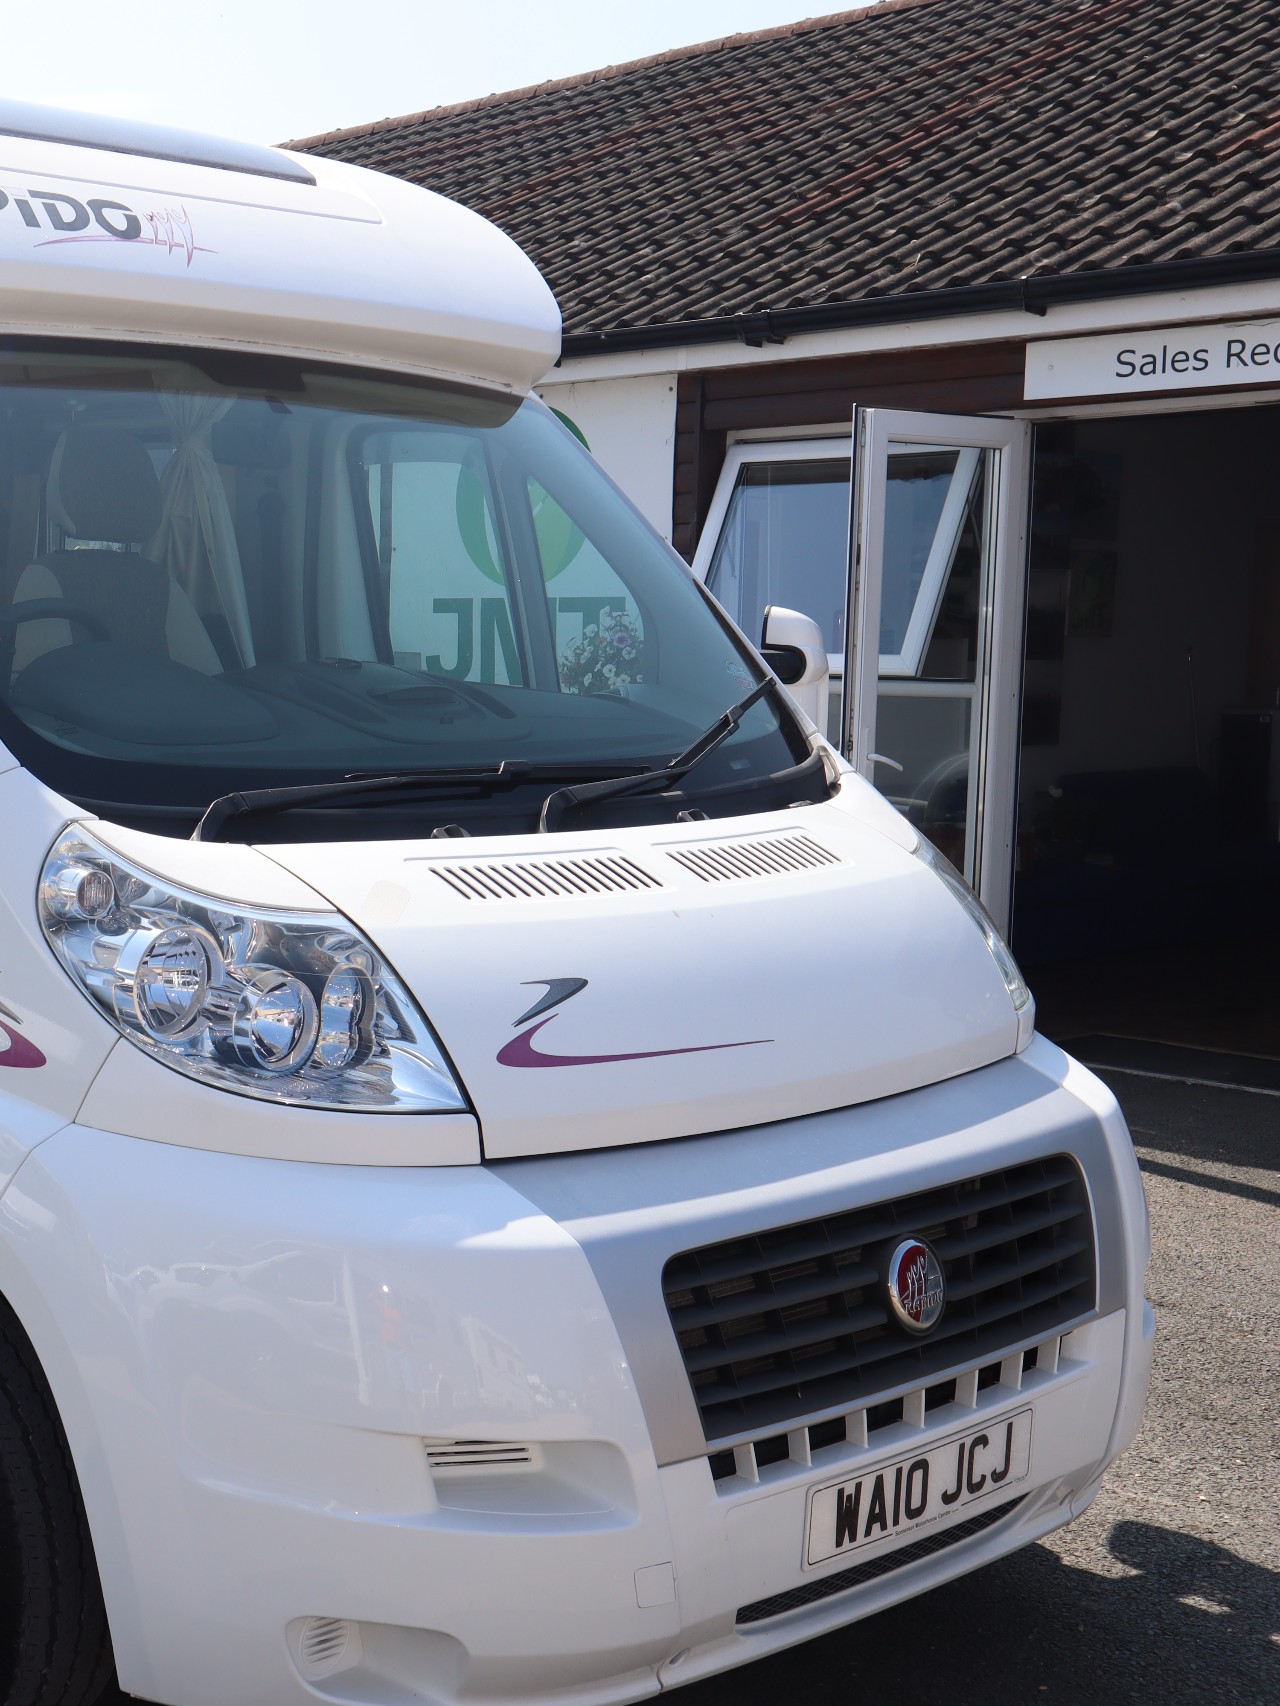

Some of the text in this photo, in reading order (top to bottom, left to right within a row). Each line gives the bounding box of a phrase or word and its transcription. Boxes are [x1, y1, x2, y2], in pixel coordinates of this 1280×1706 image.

[1115, 345, 1209, 378] Sales
[835, 1421, 1014, 1549] WA10 JCJ
